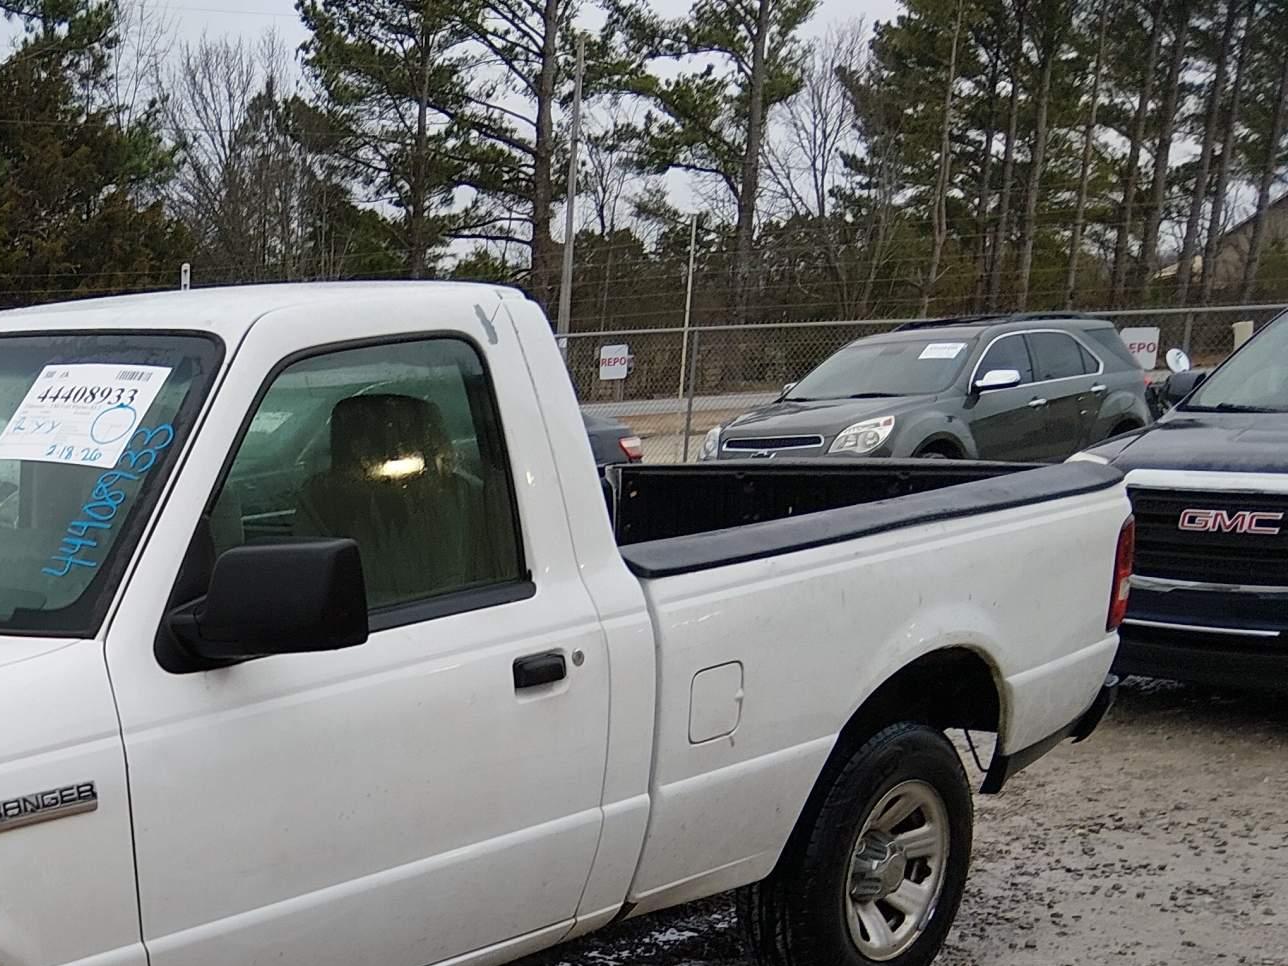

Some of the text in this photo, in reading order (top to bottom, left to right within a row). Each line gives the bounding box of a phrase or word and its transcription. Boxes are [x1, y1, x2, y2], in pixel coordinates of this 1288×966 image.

[1128, 342, 1156, 354] EPO
[601, 356, 627, 367] REPO
[37, 385, 139, 405] 44408933
[41, 422, 176, 578] 44408933
[1178, 508, 1285, 535] GMC
